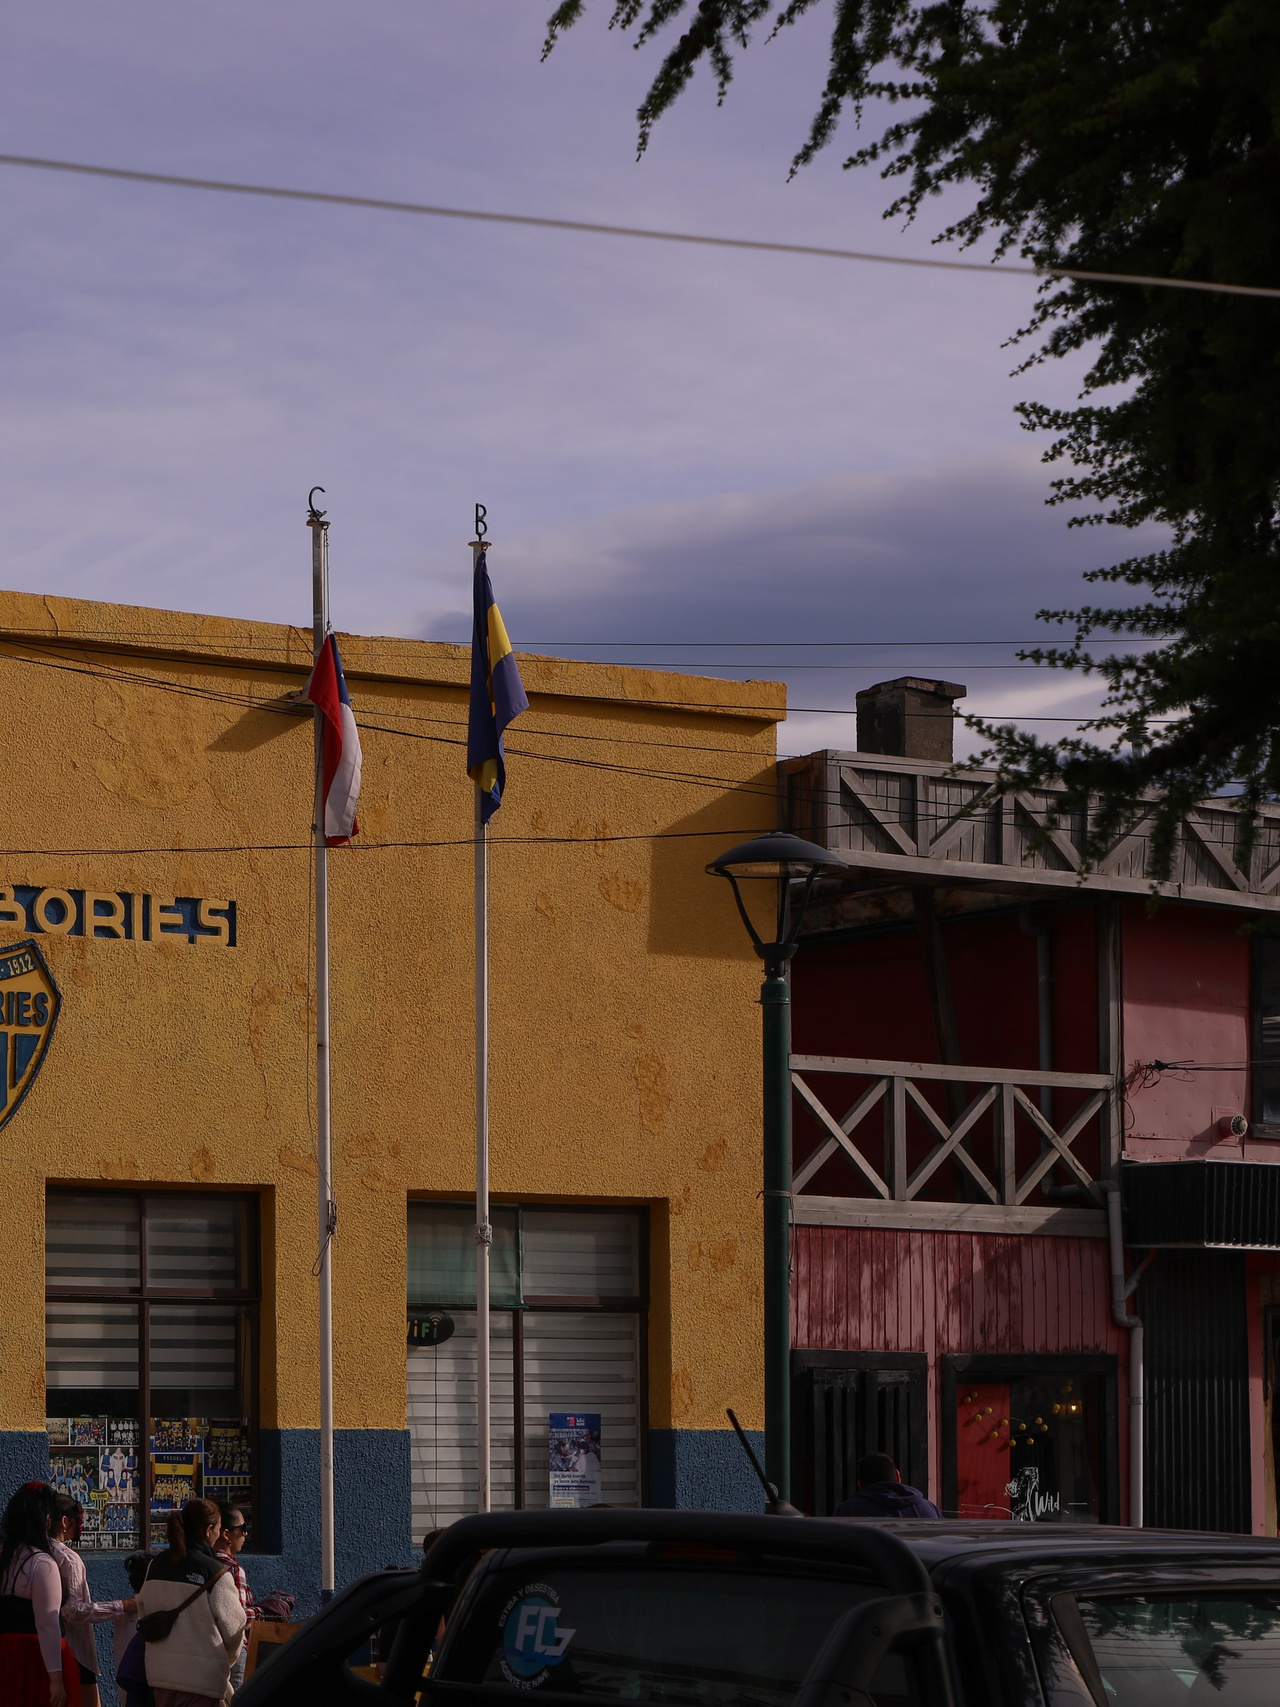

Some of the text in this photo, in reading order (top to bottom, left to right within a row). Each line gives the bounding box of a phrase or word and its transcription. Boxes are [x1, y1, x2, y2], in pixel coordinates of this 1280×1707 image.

[7, 954, 34, 976] 1912
[1035, 1491, 1060, 1517] Wild
[498, 1583, 560, 1628] ESTIBA Y DESESTIBA
[499, 1660, 521, 1689] AGENTE
[521, 1680, 532, 1690] DE
